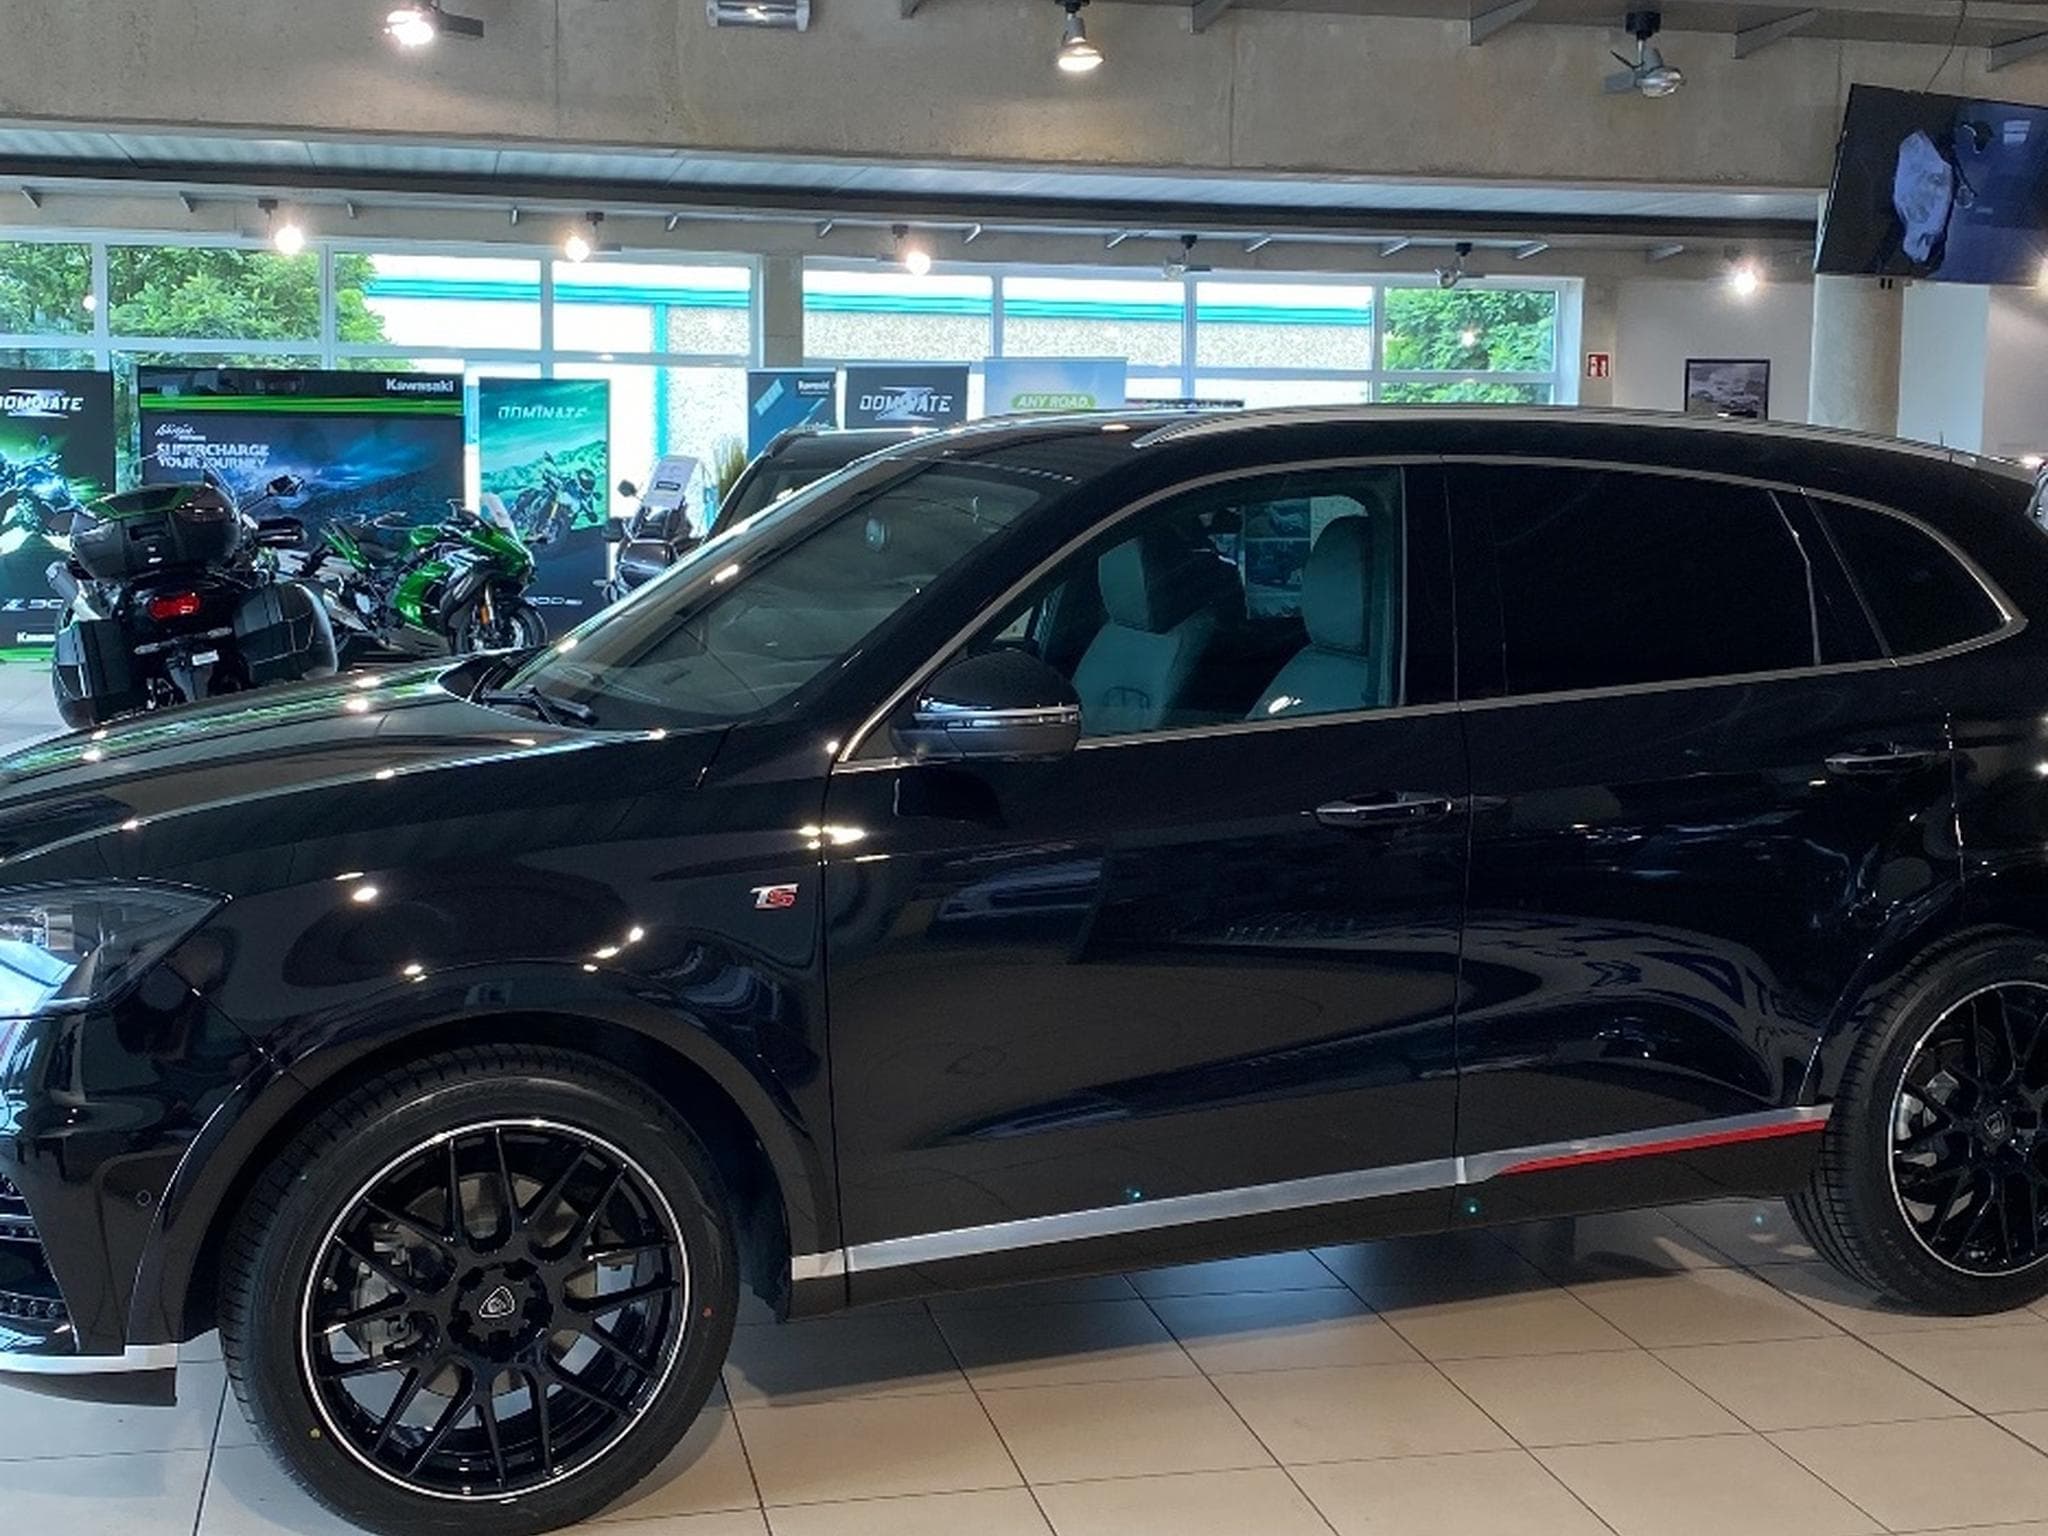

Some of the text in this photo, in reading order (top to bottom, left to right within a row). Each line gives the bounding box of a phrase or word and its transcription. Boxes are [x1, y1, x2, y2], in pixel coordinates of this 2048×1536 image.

[386, 378, 454, 392] Kawasaki
[1017, 396, 1047, 409] ANY
[156, 443, 270, 456] SUPERCHARGE
